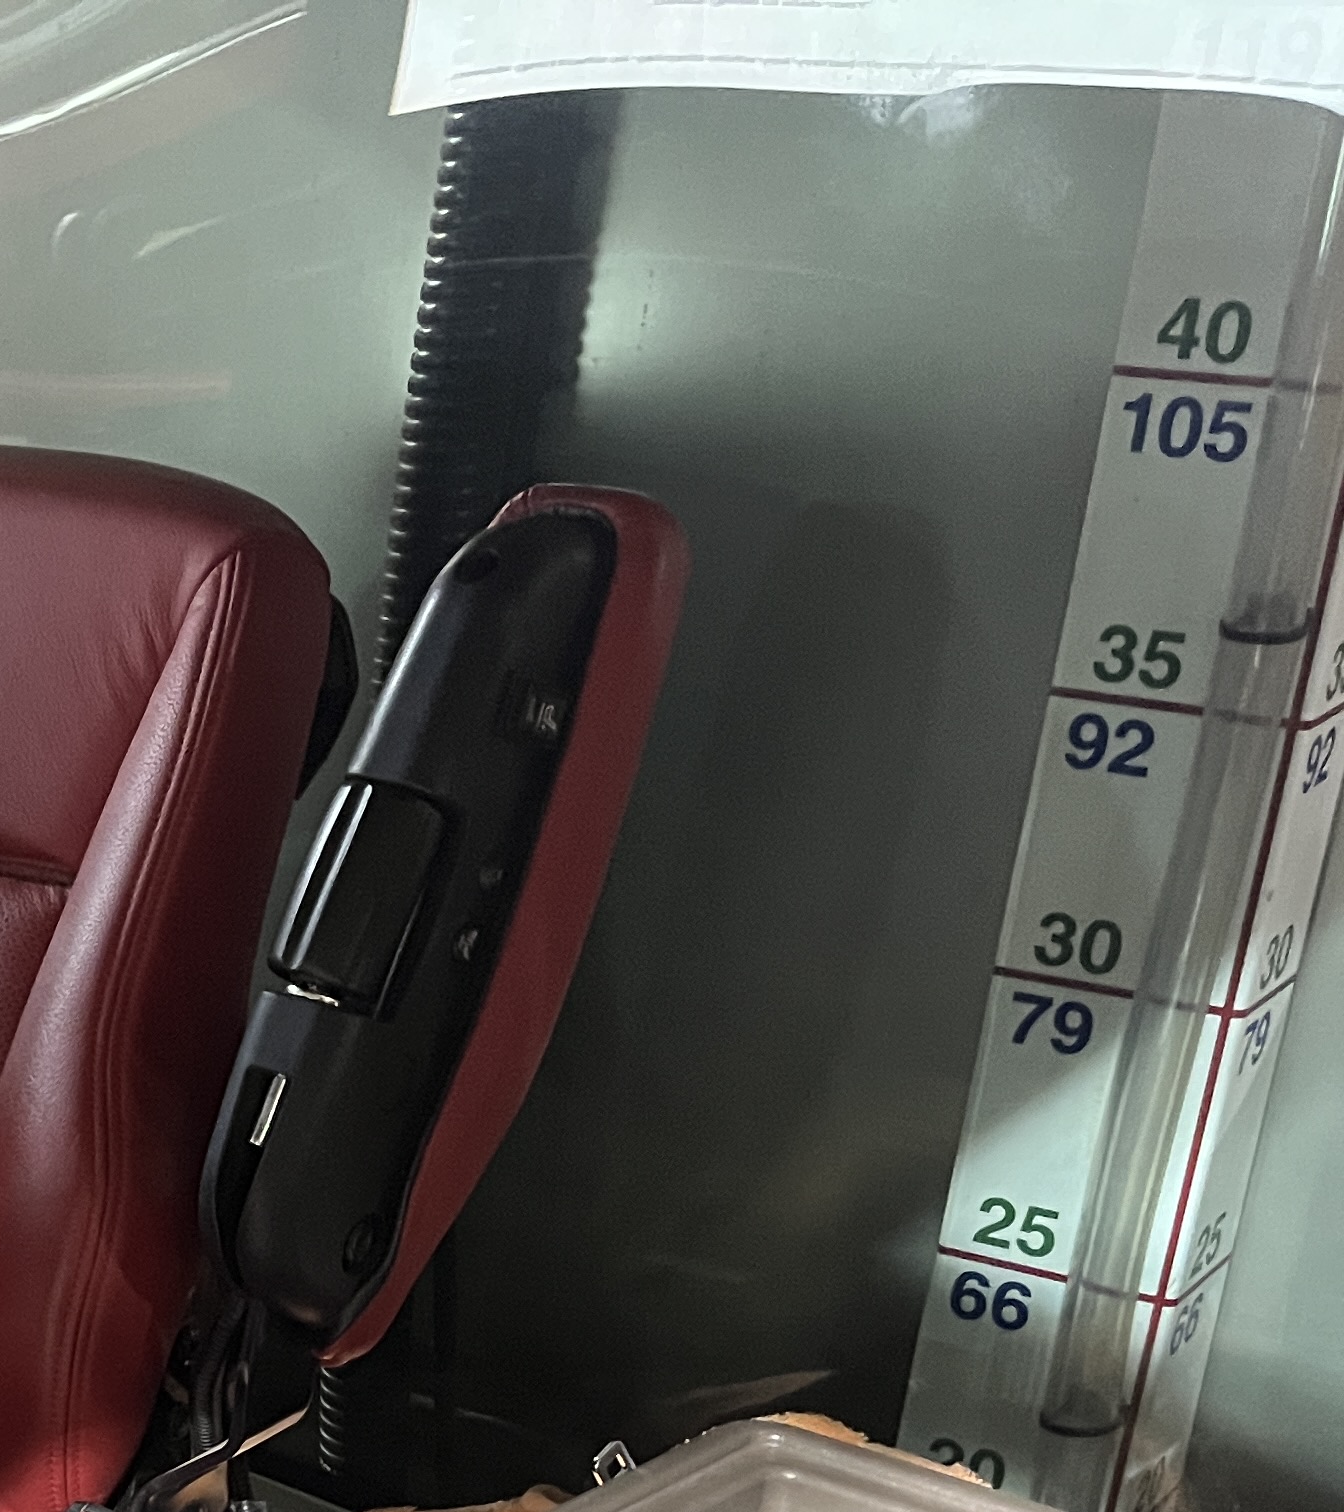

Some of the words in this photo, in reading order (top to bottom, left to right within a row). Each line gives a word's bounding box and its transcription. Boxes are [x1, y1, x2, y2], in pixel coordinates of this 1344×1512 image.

[1157, 298, 1253, 363] 40
[1123, 393, 1254, 462] 105
[1092, 625, 1188, 689] 35
[1064, 713, 1156, 777] 92
[1302, 726, 1336, 794] 92
[1033, 912, 1123, 975] 30
[1260, 925, 1294, 986] 30
[1011, 993, 1094, 1055] 79
[1236, 1011, 1271, 1075] 79
[973, 1196, 1060, 1257] 25
[1191, 1211, 1227, 1276] 25
[949, 1270, 1032, 1331] 66
[1169, 1293, 1203, 1356] 66
